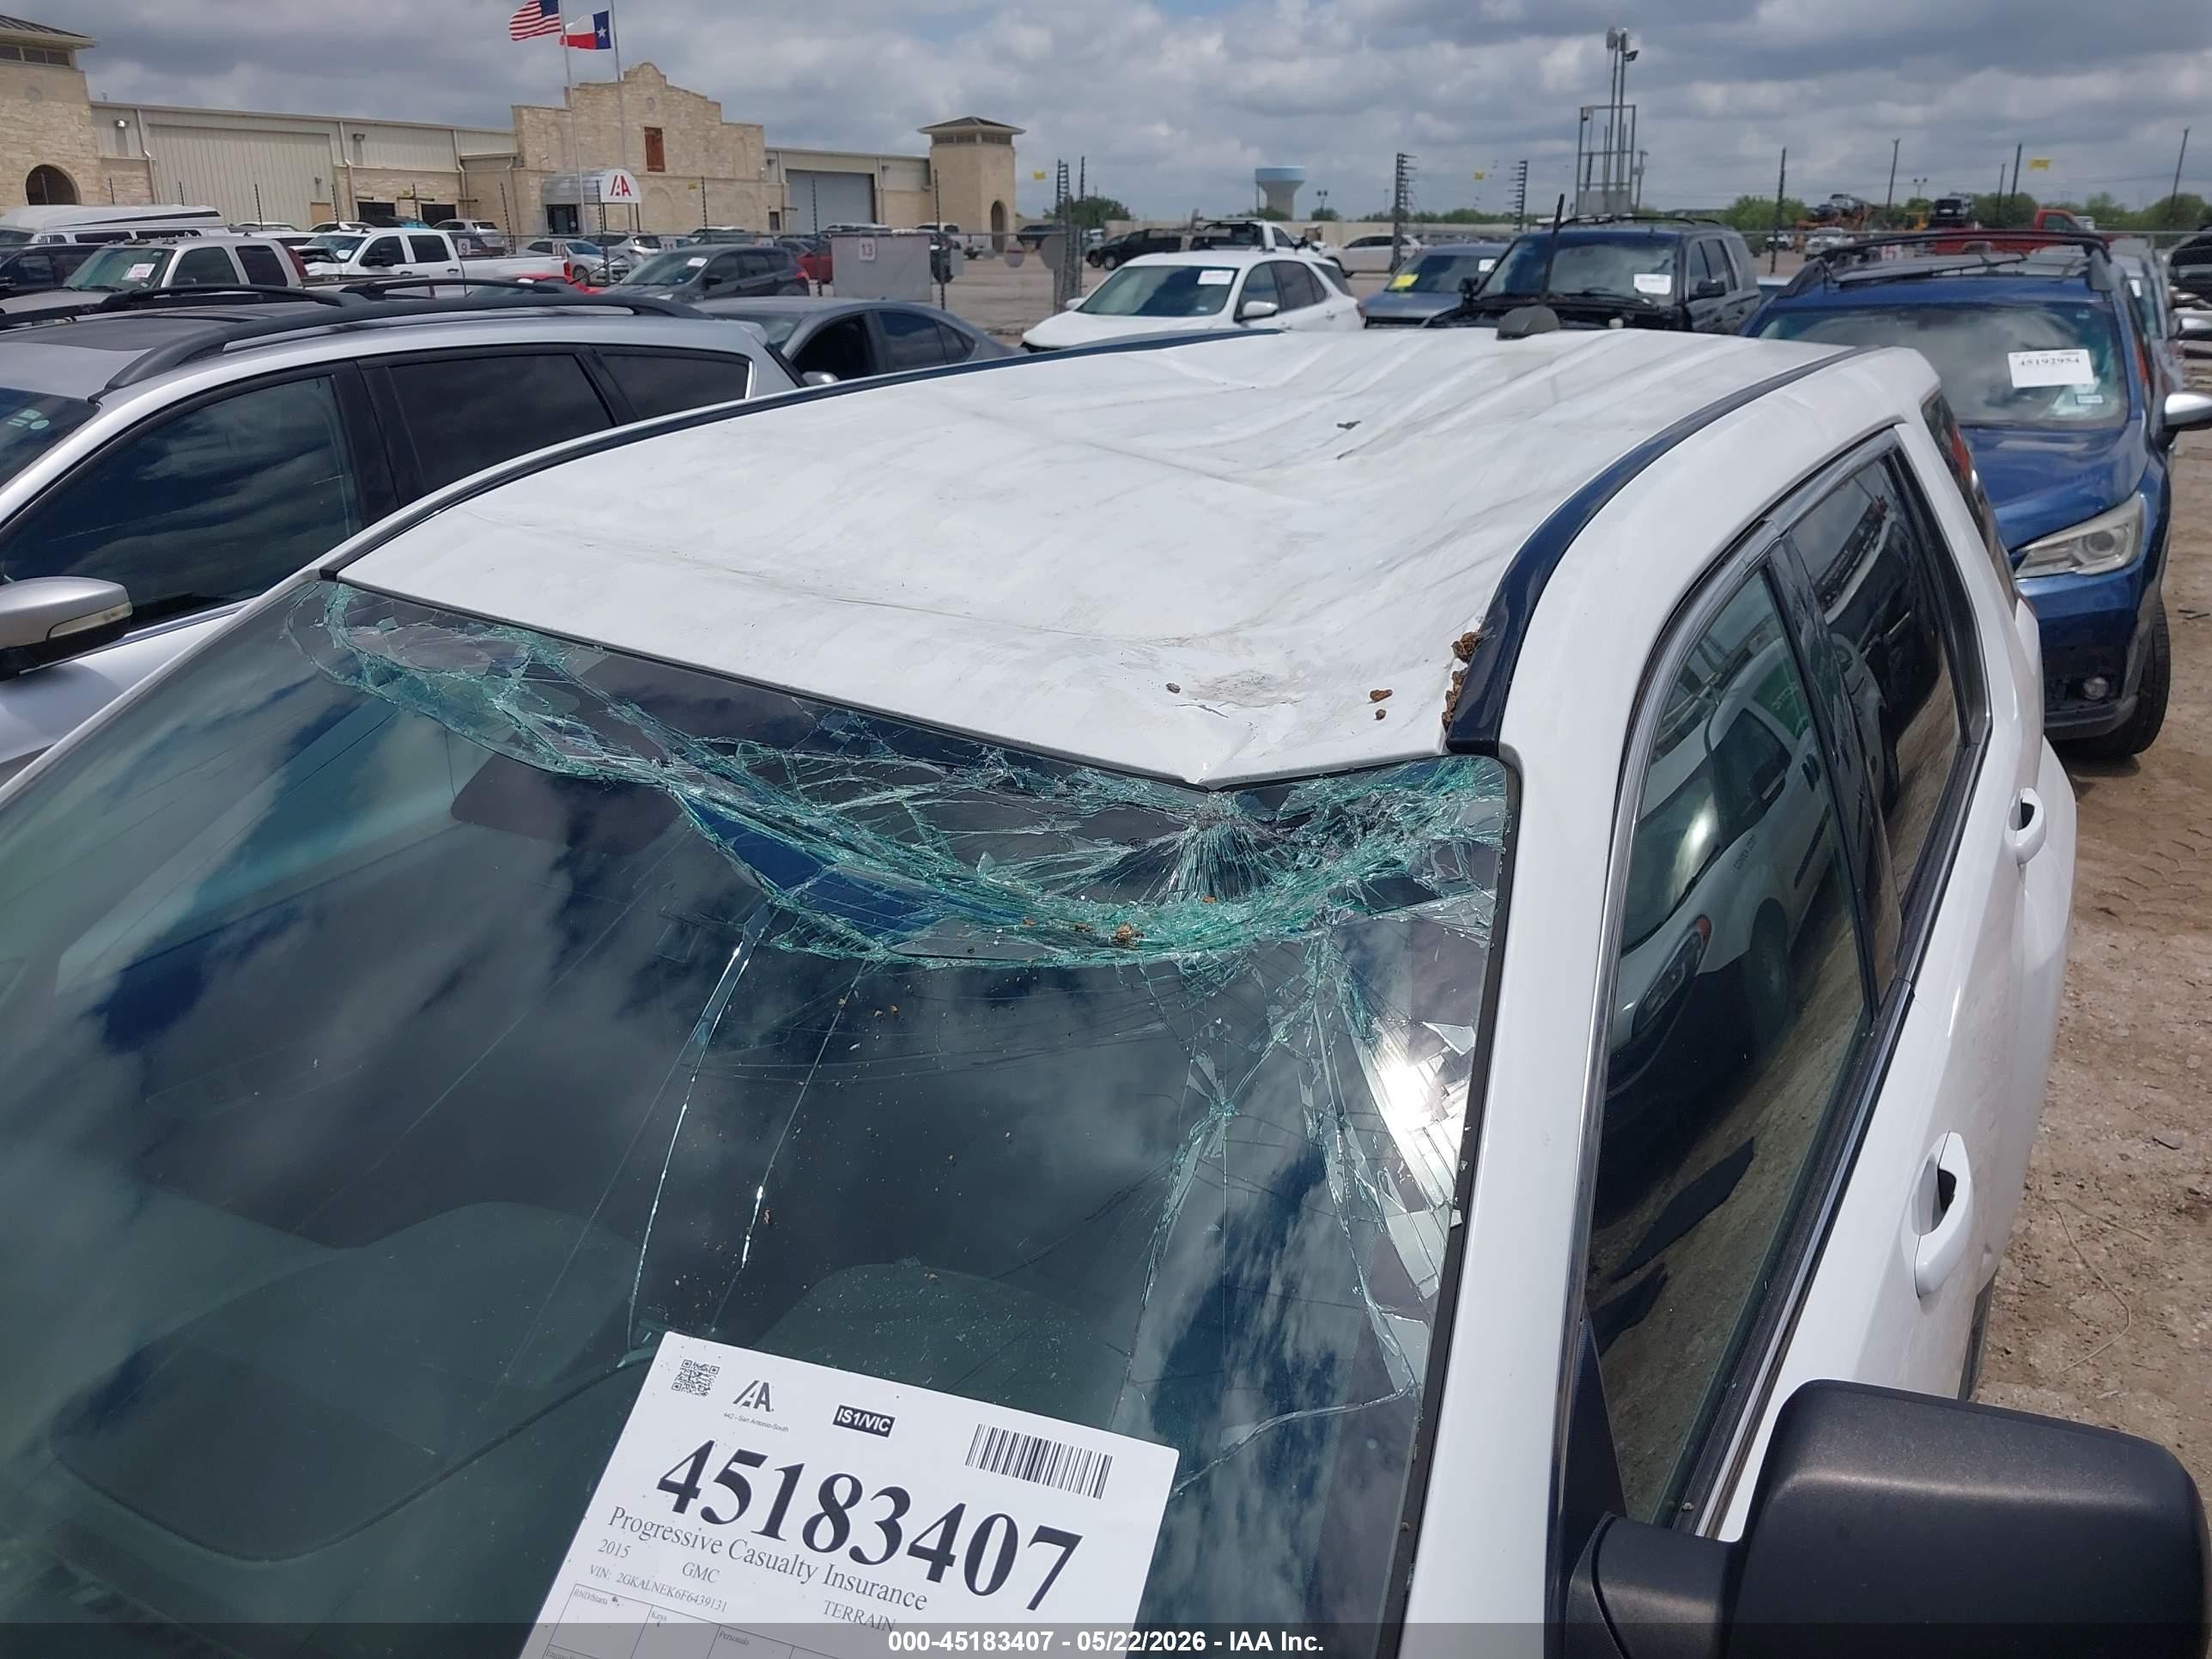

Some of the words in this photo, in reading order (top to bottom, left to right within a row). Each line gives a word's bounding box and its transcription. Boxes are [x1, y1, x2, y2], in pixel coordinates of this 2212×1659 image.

[461, 241, 468, 255] 9
[553, 244, 565, 256] 10
[861, 243, 873, 257] 13
[738, 1415, 750, 1424] San
[750, 1418, 789, 1433] Antonio-South
[836, 1407, 890, 1432] IS1/VIC
[656, 1438, 1084, 1613] 45183407
[607, 1506, 723, 1554] Progressive
[728, 1540, 820, 1585] Casualty
[823, 1563, 928, 1612] Insurance
[590, 1565, 612, 1579] VIN:
[616, 1572, 728, 1613] 2GKALNEK6F6439131
[597, 1539, 631, 1559] 2015
[682, 1561, 720, 1583] GMC
[823, 1600, 896, 1632] TERRAIN
[651, 1611, 667, 1622] Keys
[719, 1630, 750, 1646] Personals
